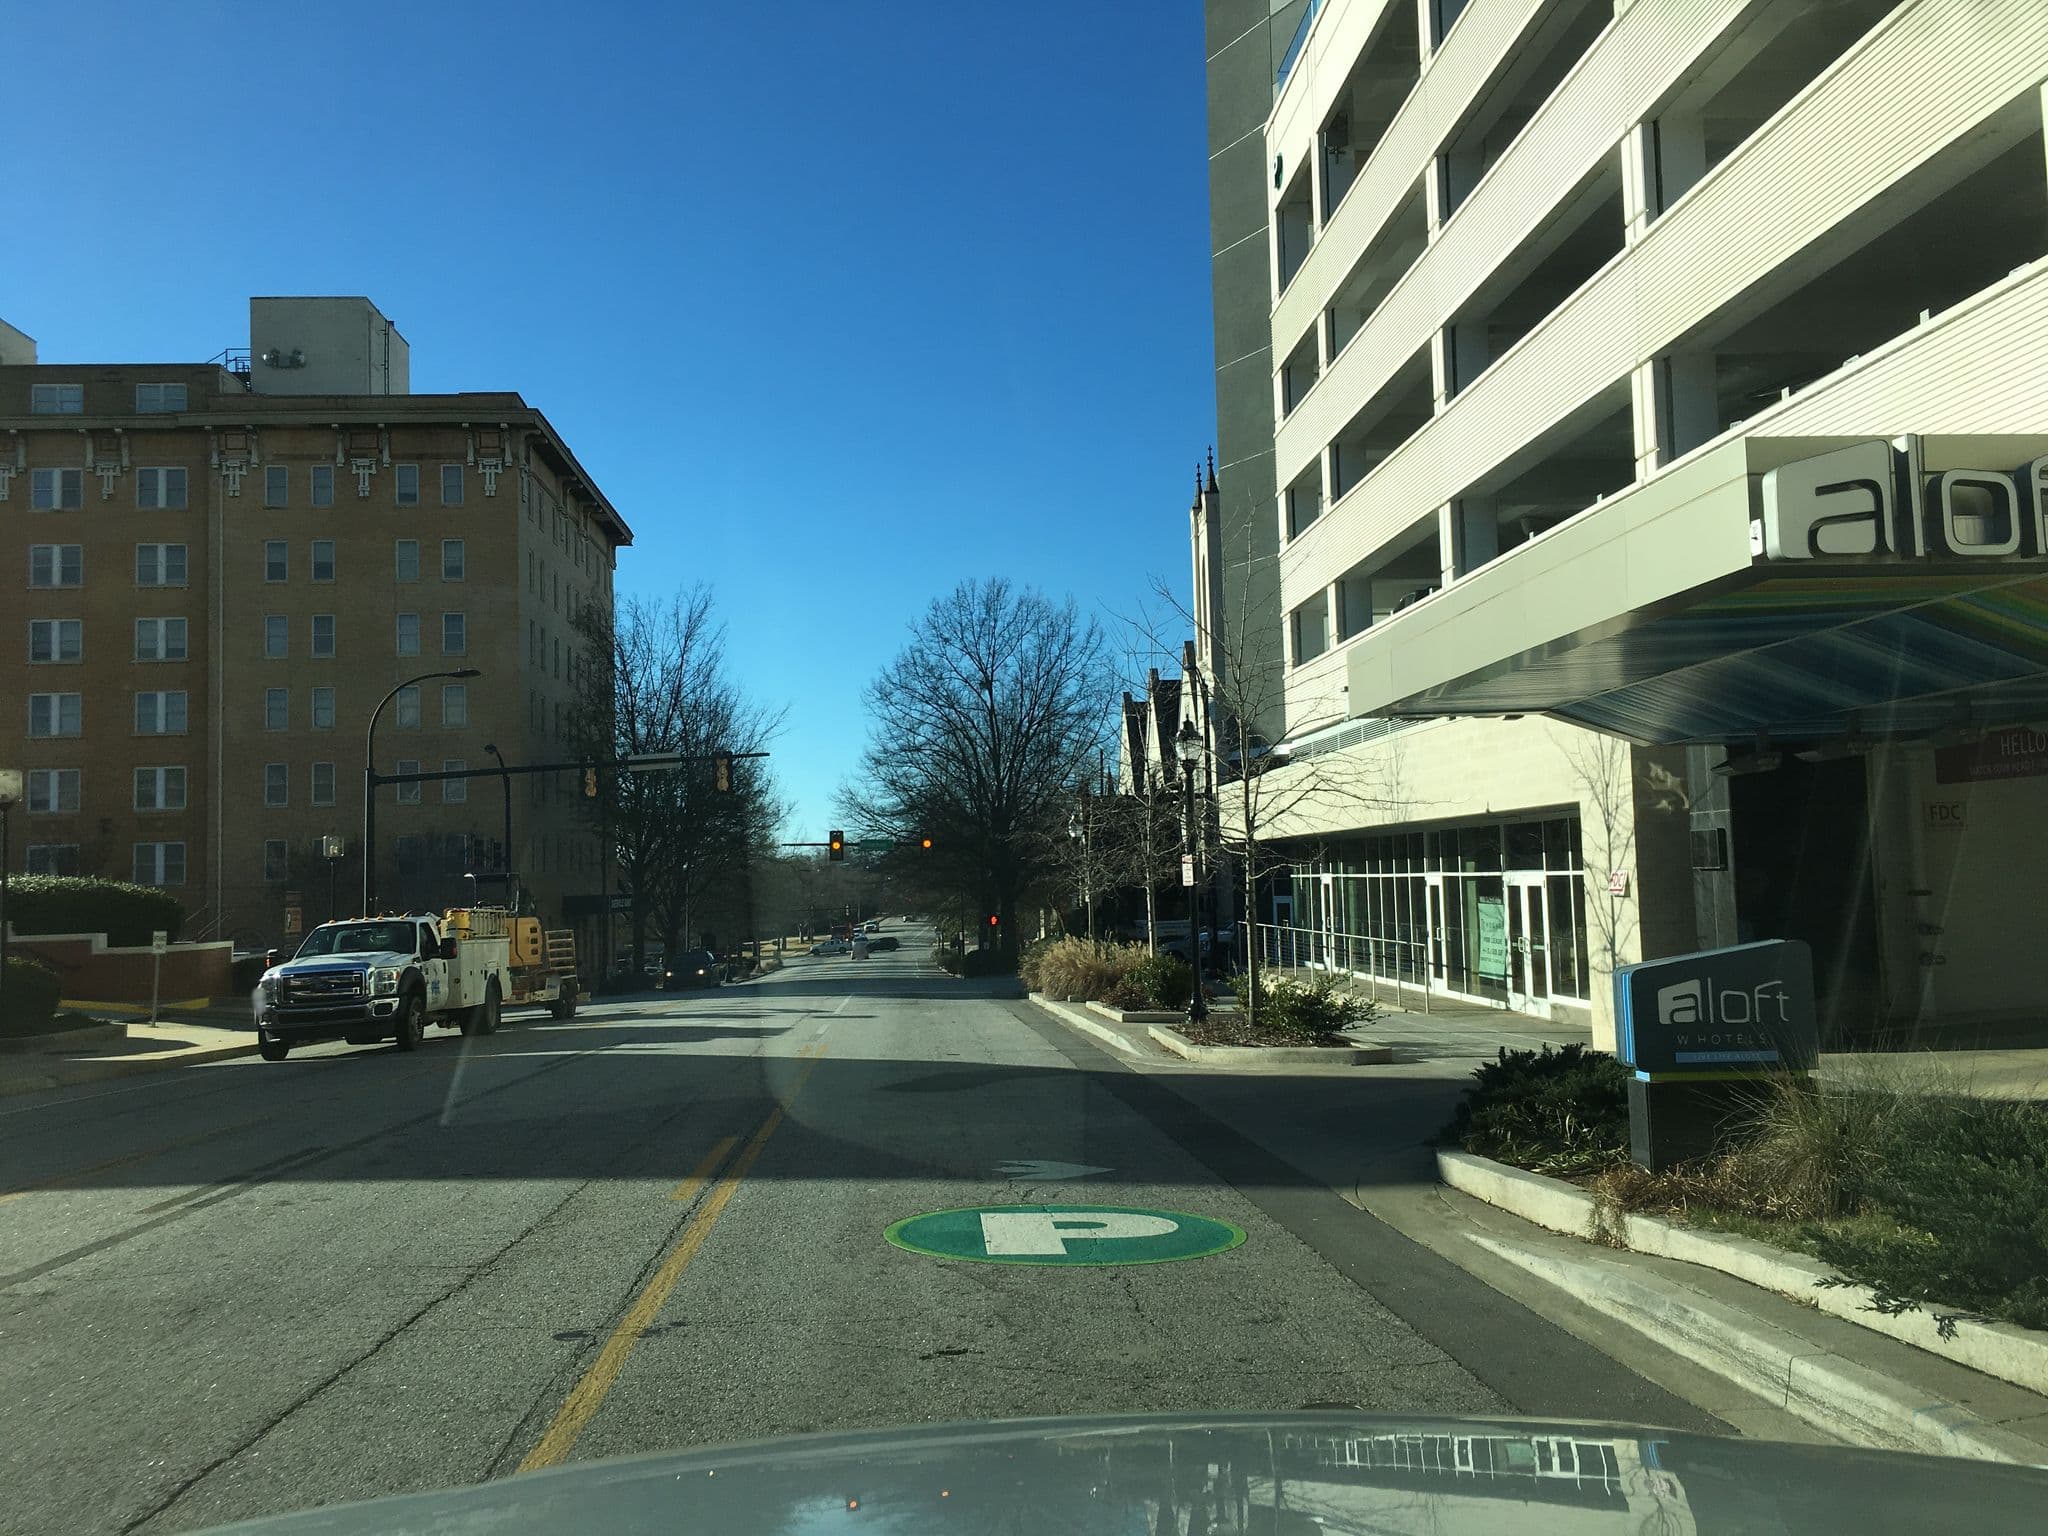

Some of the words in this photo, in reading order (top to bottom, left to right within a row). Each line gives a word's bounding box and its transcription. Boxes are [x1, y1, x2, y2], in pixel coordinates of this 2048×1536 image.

[1930, 804, 1961, 821] FDC
[1658, 977, 1790, 1024] aloft
[1677, 1034, 1688, 1045] W
[1698, 1033, 1767, 1045] HOTELS
[979, 1212, 1179, 1255] P
